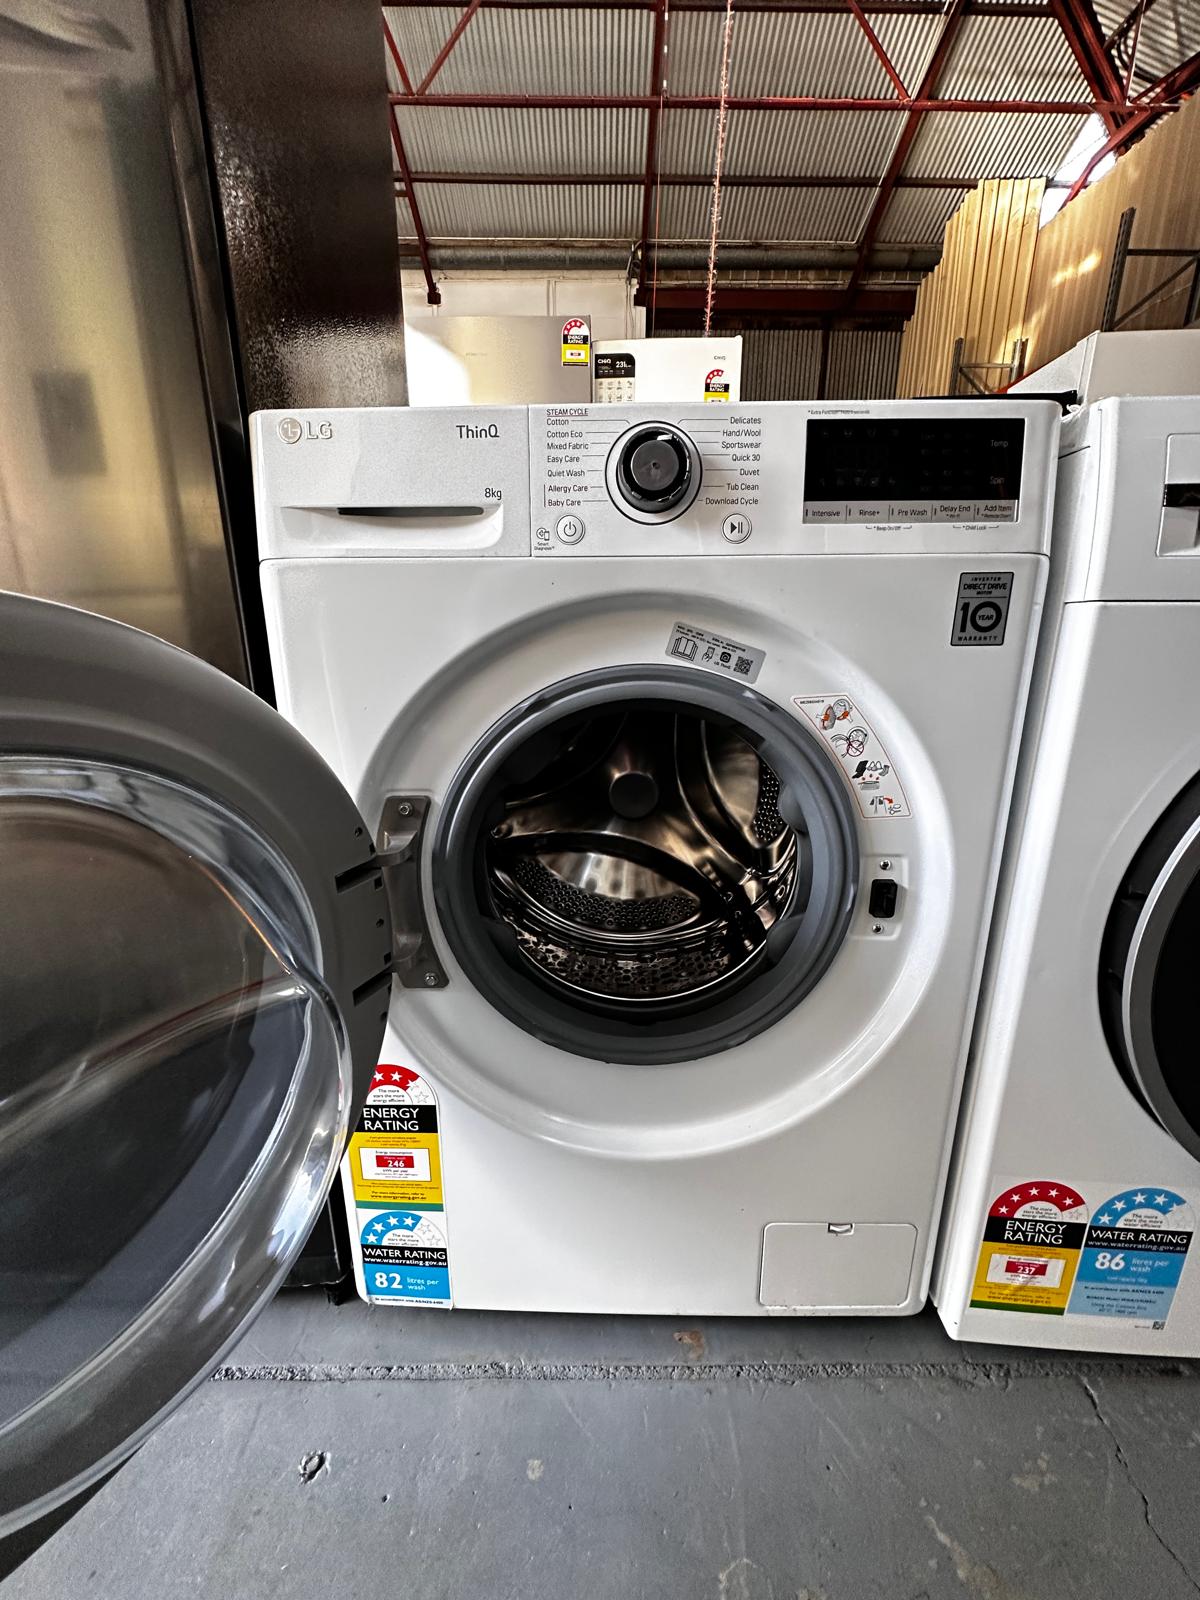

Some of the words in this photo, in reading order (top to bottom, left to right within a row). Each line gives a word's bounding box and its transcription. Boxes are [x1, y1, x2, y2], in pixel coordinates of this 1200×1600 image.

[546, 408, 568, 416] STEAM
[569, 407, 589, 416] CYCLE
[546, 418, 570, 426] Cotton
[730, 416, 762, 424] Delicates
[304, 420, 333, 440] LG
[456, 423, 500, 439] ThinQ
[546, 430, 569, 439] Cotton
[570, 430, 583, 438] Eco
[722, 429, 761, 437] Hand/Wool
[547, 442, 567, 450] Mixed
[568, 442, 589, 450] Fabric
[721, 441, 761, 449] Sportswear
[547, 455, 563, 464] Easy
[564, 455, 580, 463] Care
[547, 469, 565, 477] Quiet
[566, 469, 585, 477] Wash
[740, 468, 760, 476] Duvet
[548, 485, 571, 493] Allergy
[484, 487, 502, 501] 8kg
[548, 499, 564, 507] Baby
[740, 497, 758, 506] Cycle
[987, 582, 1008, 590] DRIVE
[960, 601, 1002, 632] 10
[363, 1107, 419, 1118] ENERGY
[364, 1120, 419, 1131] RATING
[1005, 1220, 1067, 1234] ENERGY
[1004, 1231, 1063, 1245] RATING
[1091, 1229, 1134, 1241] WATER
[1139, 1232, 1187, 1244] RATING
[1088, 1240, 1186, 1251] www.waterrating.gov.au
[363, 1247, 402, 1258] WATER
[404, 1250, 446, 1260] RATING
[364, 1257, 447, 1266] www.waterrating.gov.au
[1095, 1252, 1126, 1271] 86
[1131, 1258, 1152, 1266] litres
[1017, 1266, 1036, 1274] 237
[374, 1272, 403, 1289] 82
[406, 1276, 425, 1284] litres
